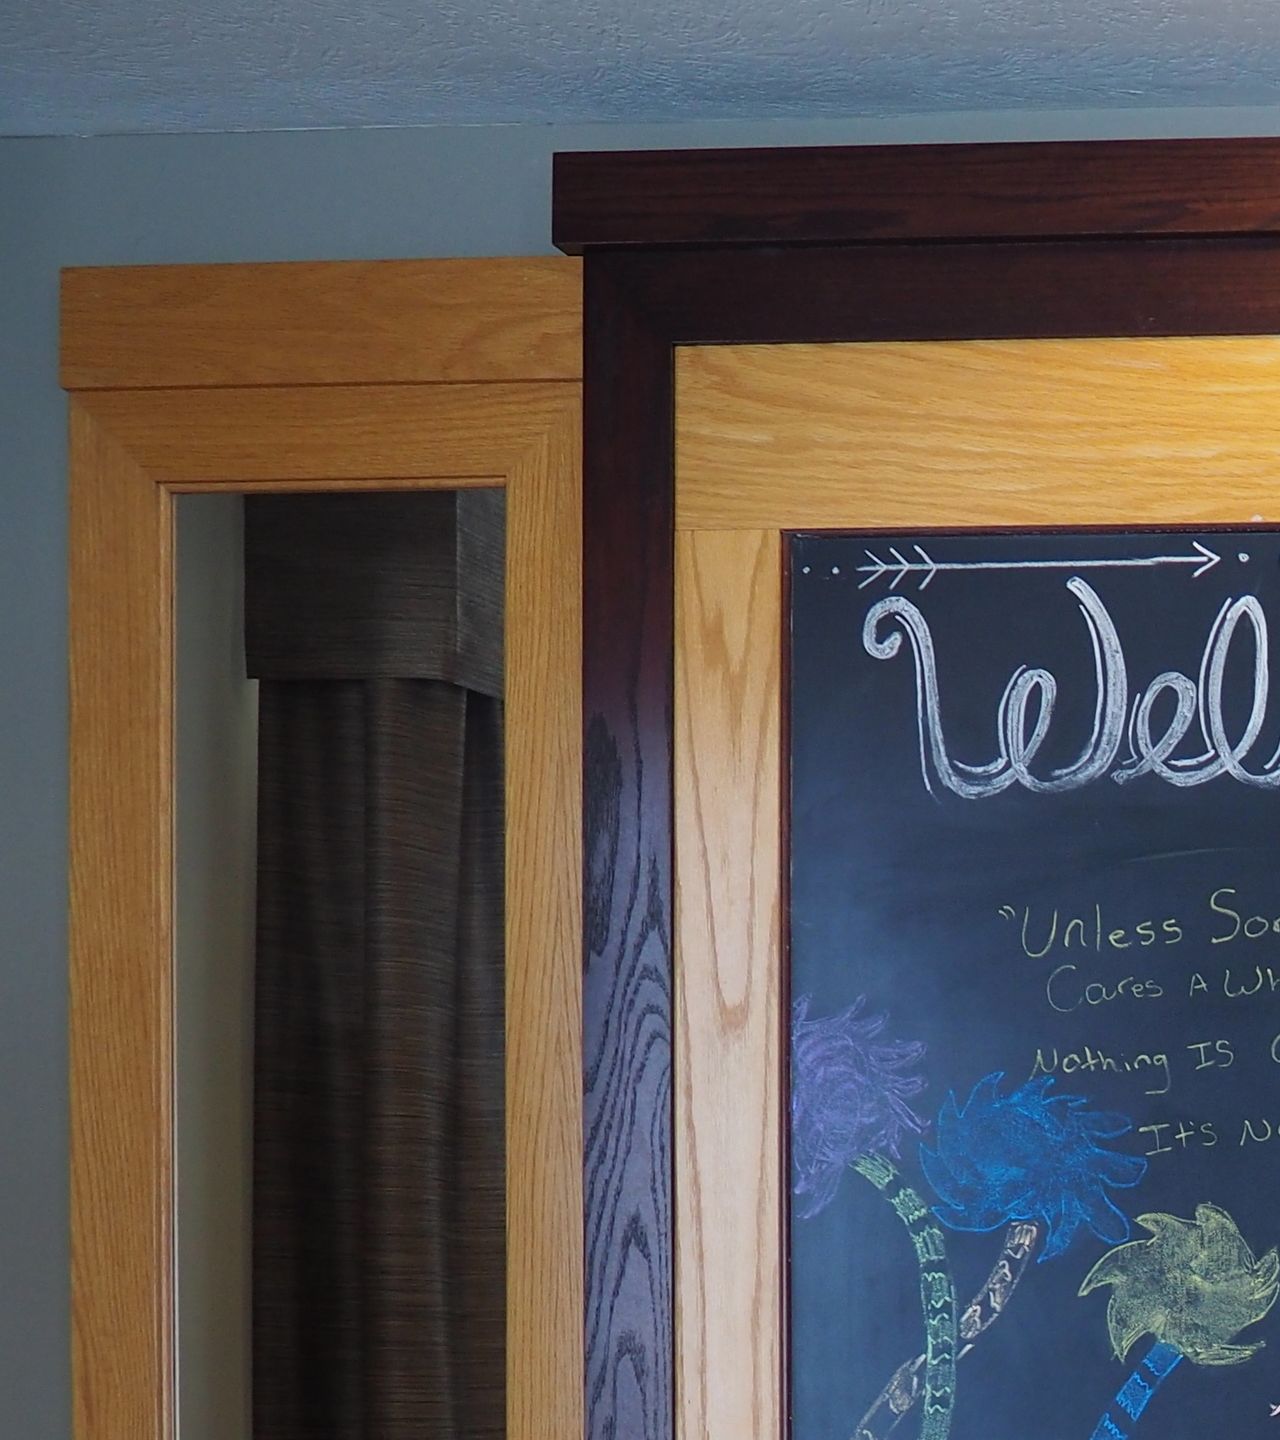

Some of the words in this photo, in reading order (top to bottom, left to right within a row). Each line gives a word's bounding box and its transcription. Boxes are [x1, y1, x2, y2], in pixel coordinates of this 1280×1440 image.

[1047, 964, 1163, 1012] Cares
[1189, 973, 1208, 997] A
[1029, 1046, 1171, 1094] Nothing
